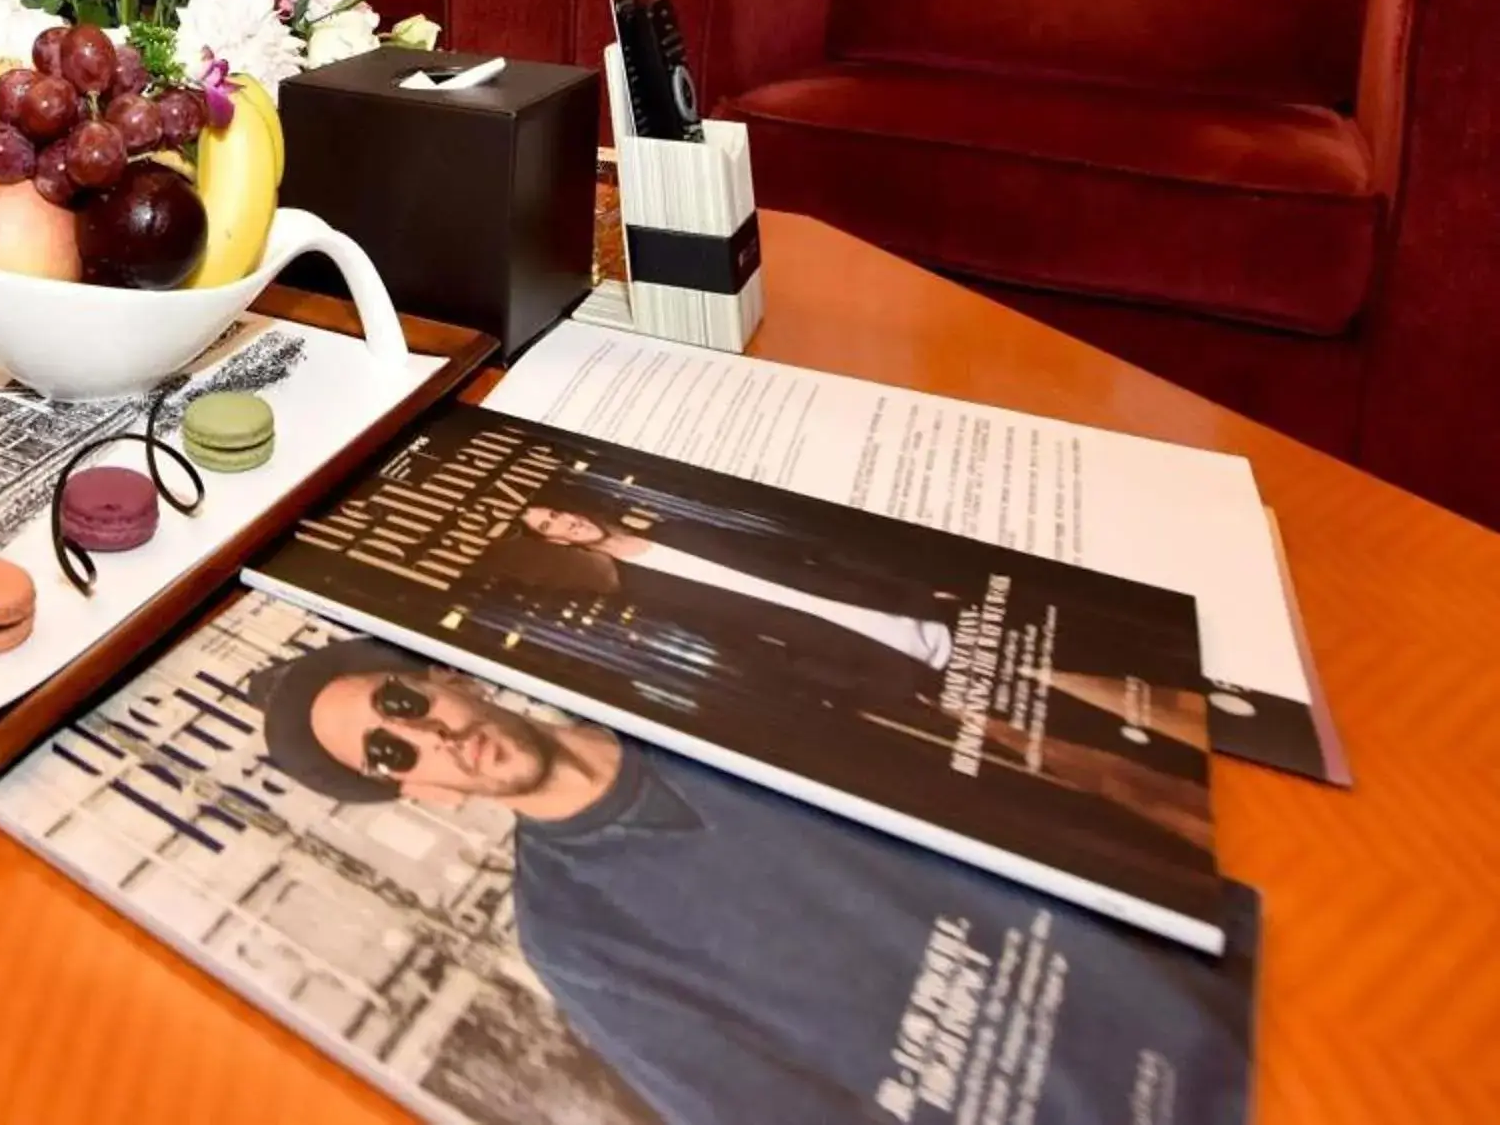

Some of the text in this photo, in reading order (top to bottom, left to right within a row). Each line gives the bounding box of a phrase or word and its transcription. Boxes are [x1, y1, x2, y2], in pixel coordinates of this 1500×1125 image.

[295, 499, 375, 551] the
[346, 430, 524, 591] pullman
[410, 446, 562, 591] magazine
